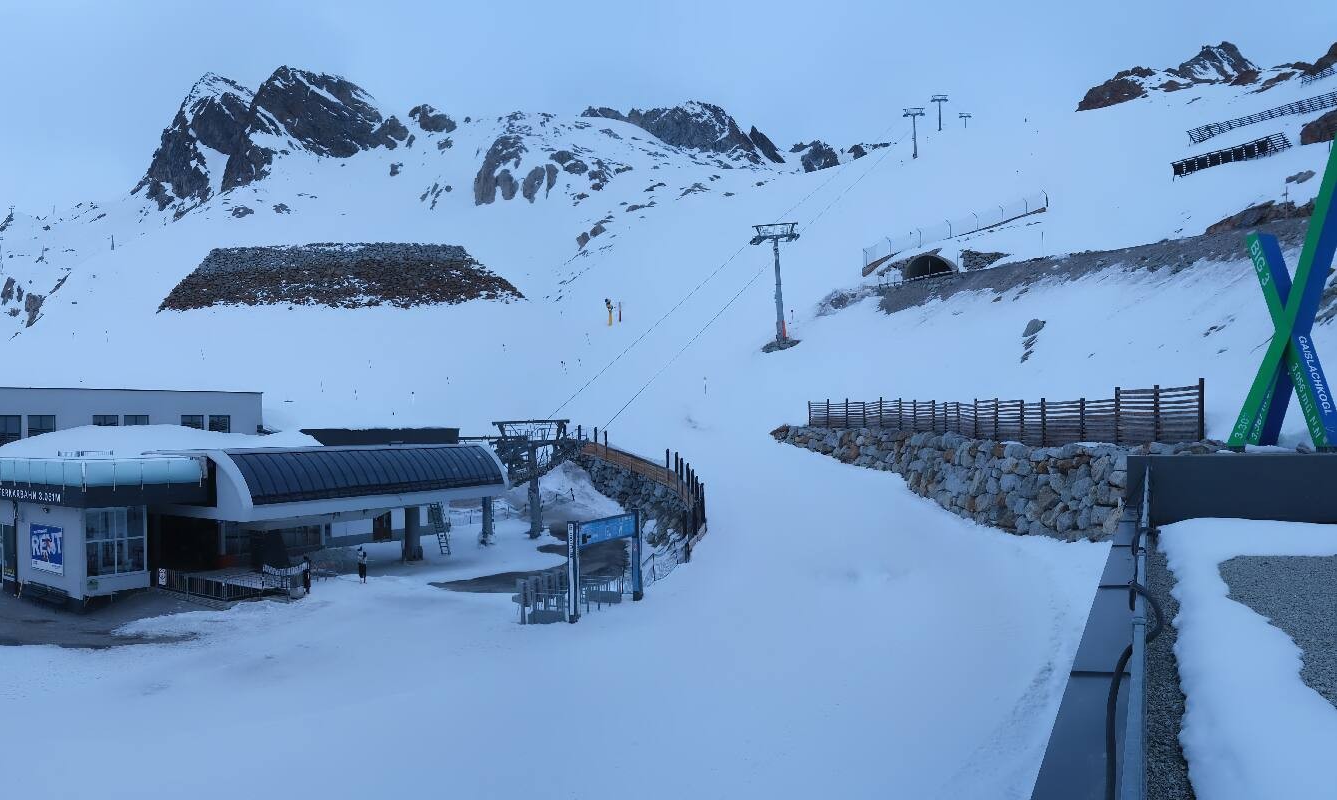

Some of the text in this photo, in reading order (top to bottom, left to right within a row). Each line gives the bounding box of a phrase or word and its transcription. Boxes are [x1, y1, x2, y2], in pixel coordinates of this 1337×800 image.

[1250, 239, 1270, 287] BIG 3
[1298, 335, 1333, 416] GAISLACHKOGL
